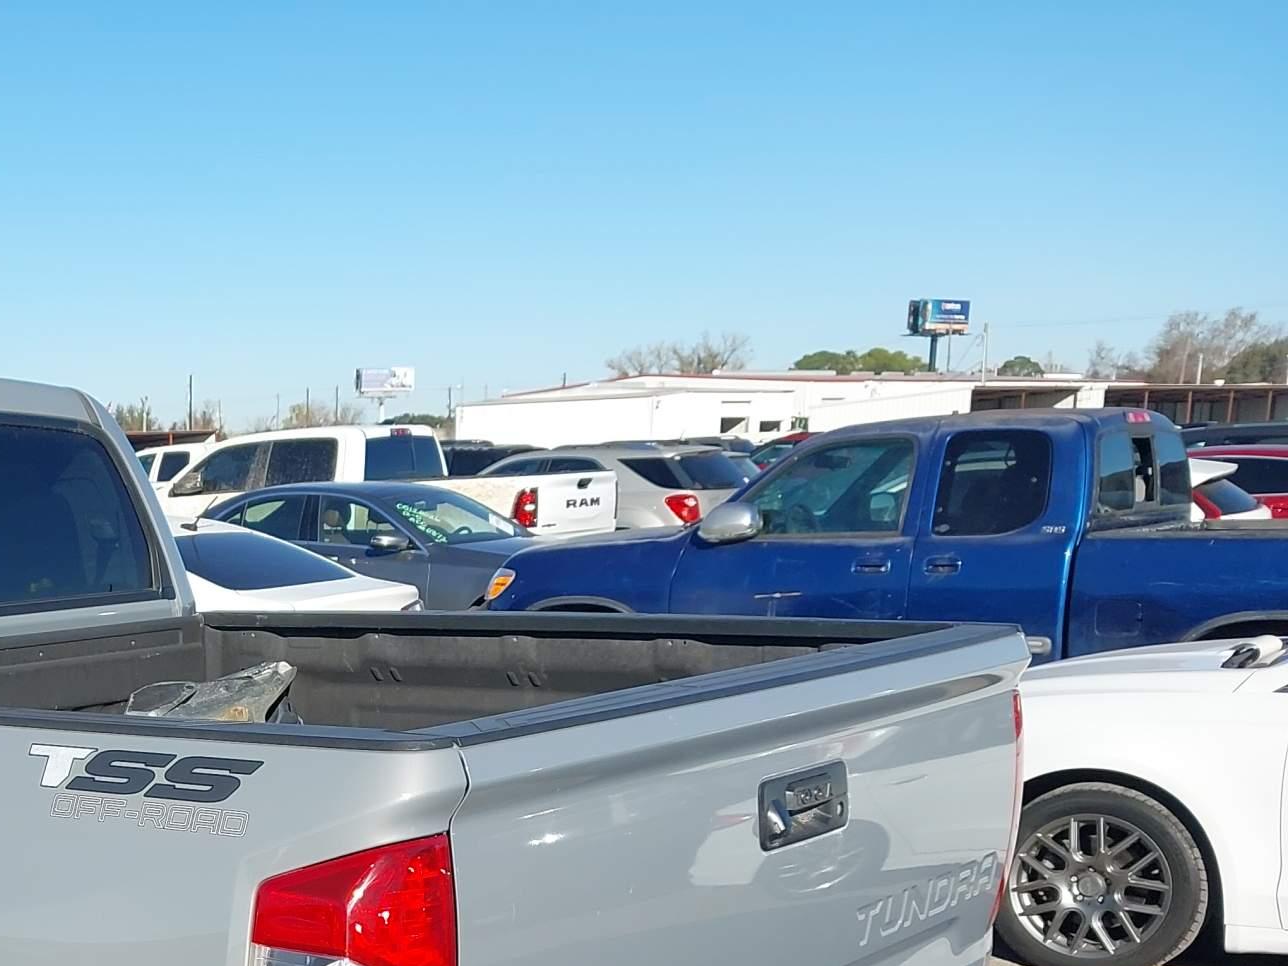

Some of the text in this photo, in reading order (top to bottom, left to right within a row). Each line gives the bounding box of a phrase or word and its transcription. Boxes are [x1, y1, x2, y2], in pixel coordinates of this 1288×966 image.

[566, 497, 601, 509] RAM
[28, 743, 265, 803] TSS
[50, 793, 249, 838] OFF-ROAD
[856, 850, 998, 947] TUNDRA
